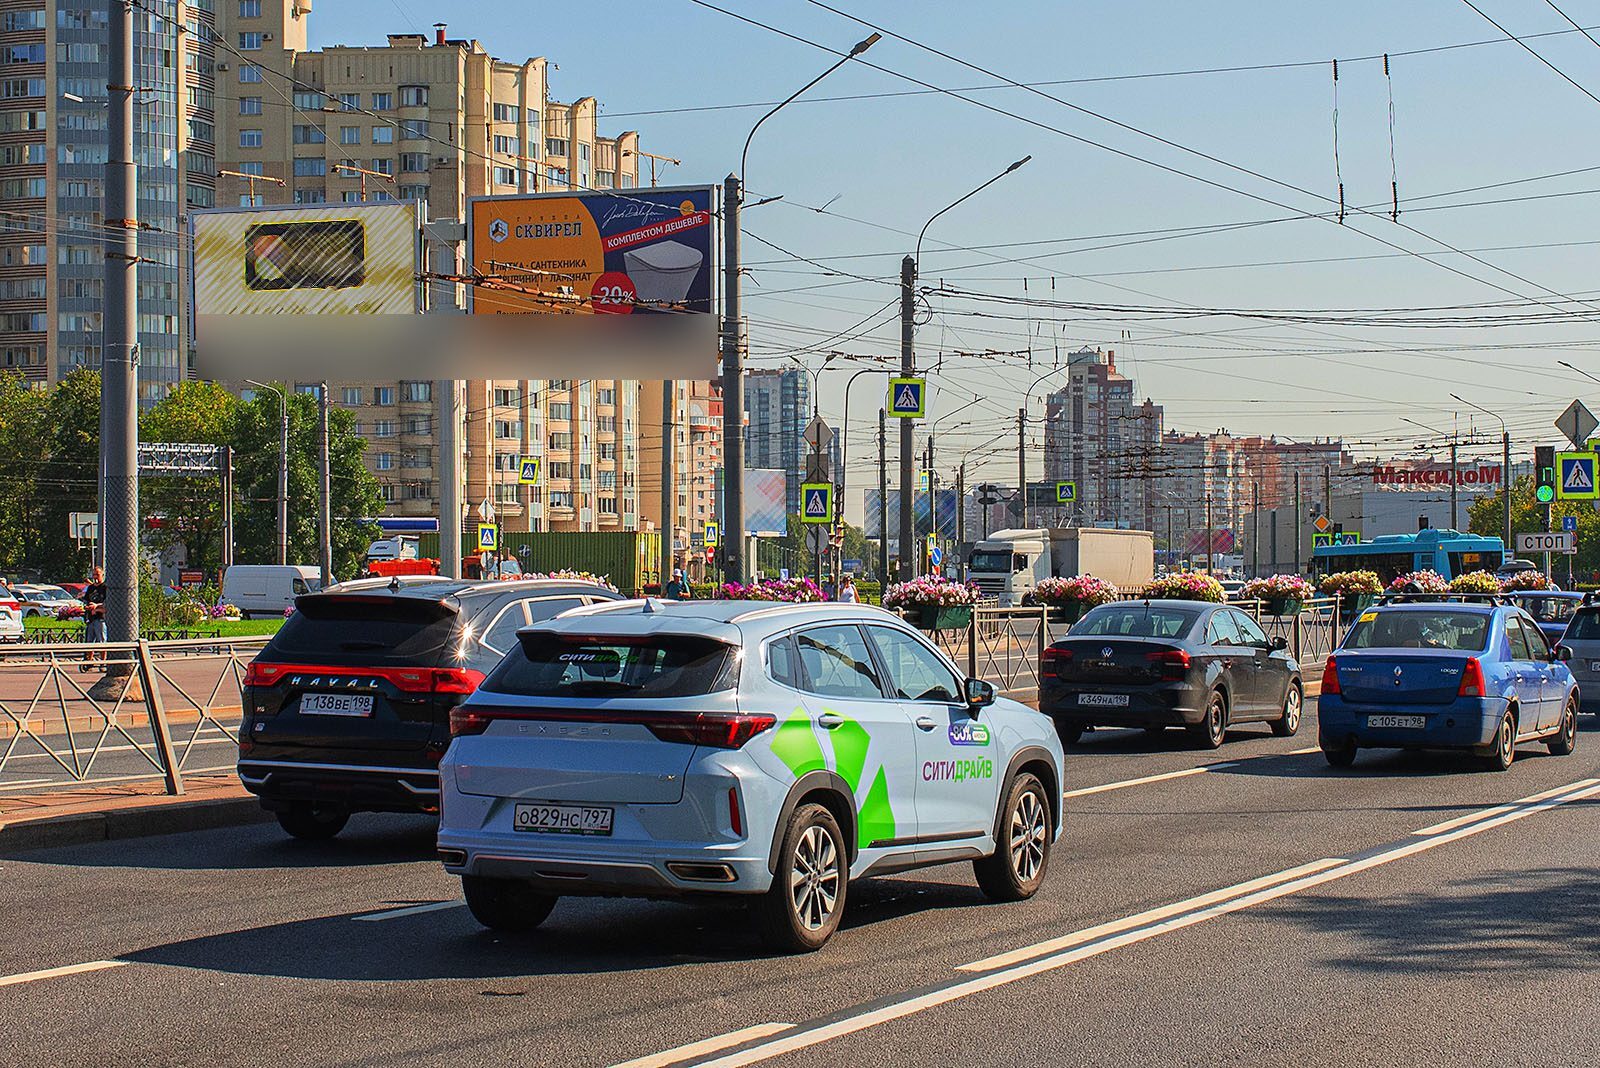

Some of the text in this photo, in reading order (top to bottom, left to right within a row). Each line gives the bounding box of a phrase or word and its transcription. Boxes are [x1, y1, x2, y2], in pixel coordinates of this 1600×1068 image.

[515, 222, 582, 239] СКВИРЕЛ
[607, 214, 704, 248] КОМПЛЕКТОМ ДЕШЕВЛЕ
[530, 259, 587, 270] САНТЕХНИКА
[550, 272, 592, 283] ЛАМИНАТ
[600, 285, 634, 305] 20%
[1524, 536, 1564, 549] СТОП
[291, 676, 379, 689] HAVAL
[922, 755, 993, 783] СИТИДРАЙВ
